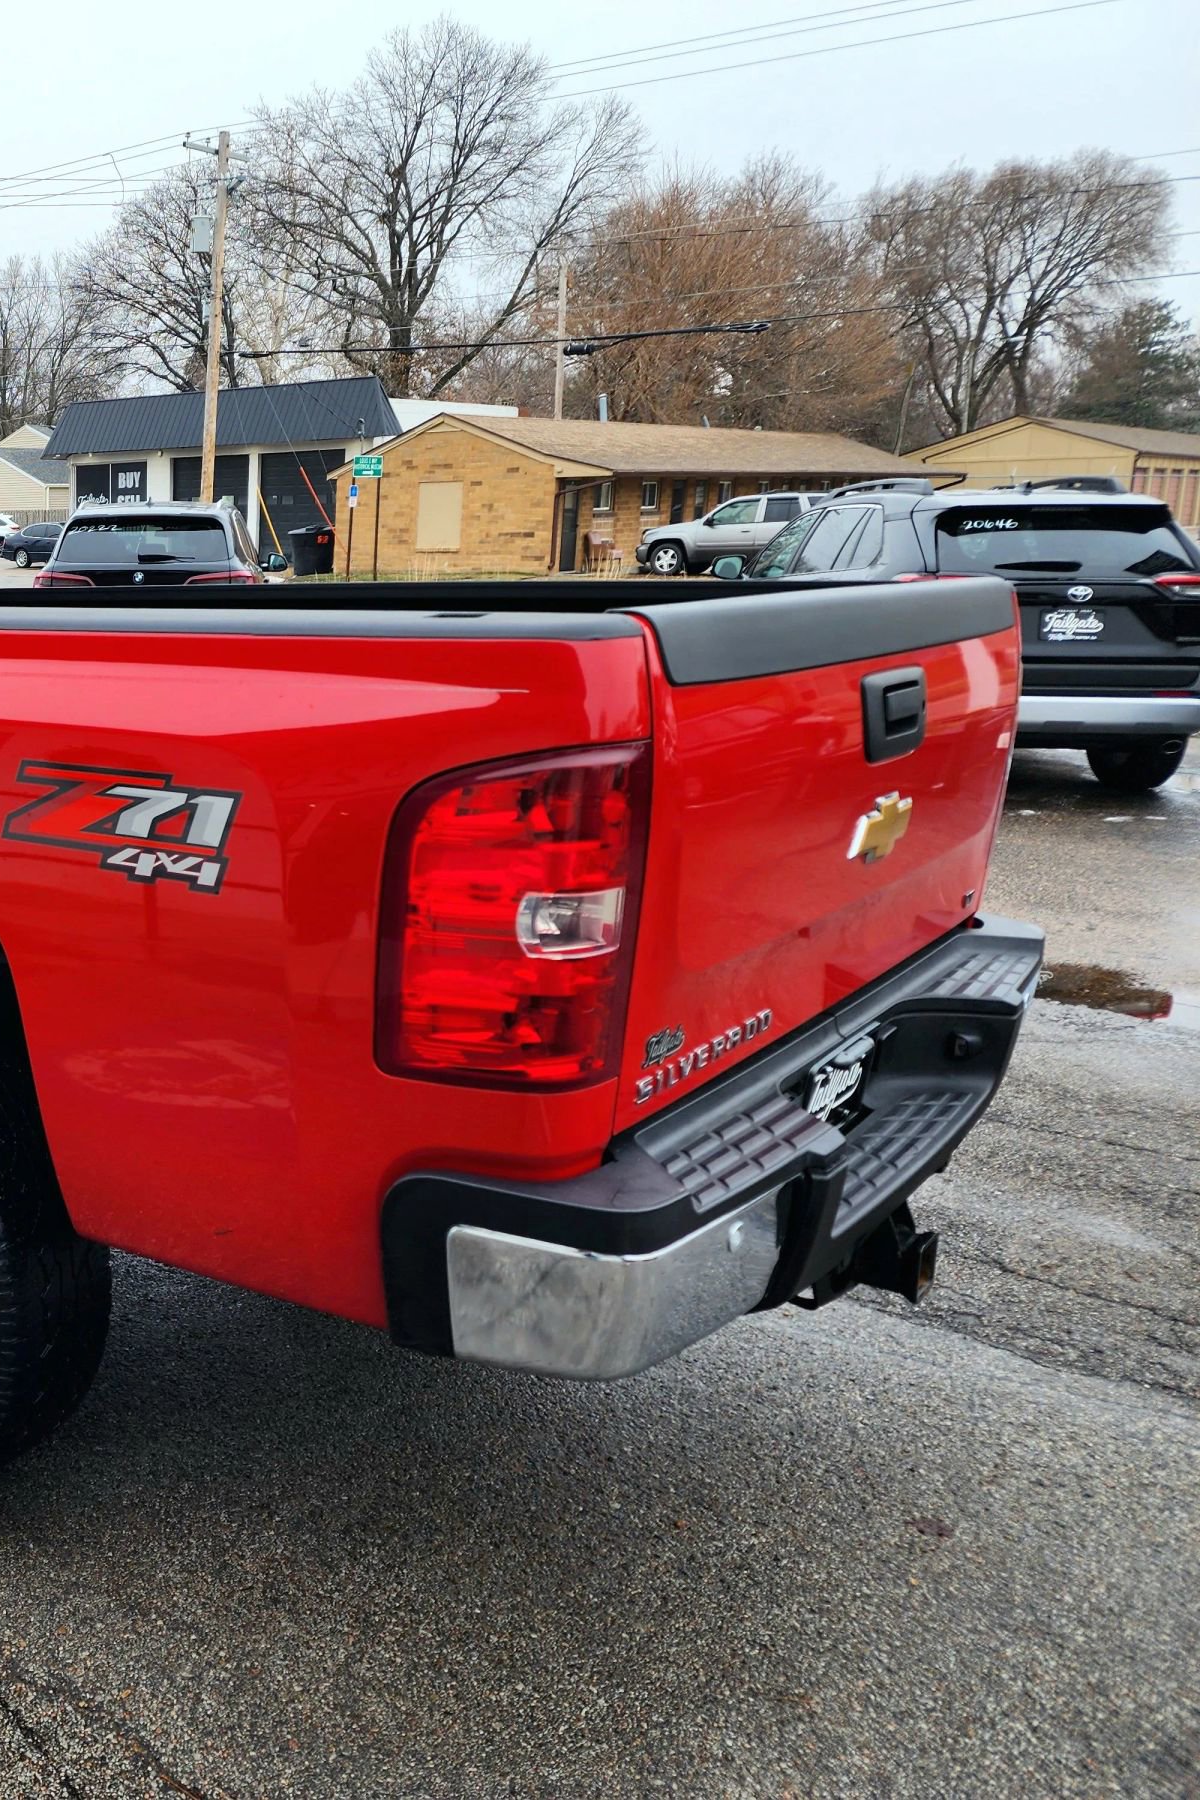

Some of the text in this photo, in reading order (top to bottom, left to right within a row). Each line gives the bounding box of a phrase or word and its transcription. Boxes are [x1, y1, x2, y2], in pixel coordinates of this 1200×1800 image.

[118, 471, 141, 489] BUY
[962, 518, 1019, 530] 20646
[1043, 611, 1105, 635] Tailgate
[2, 758, 244, 857] Z71
[634, 1008, 773, 1105] SILVERADO
